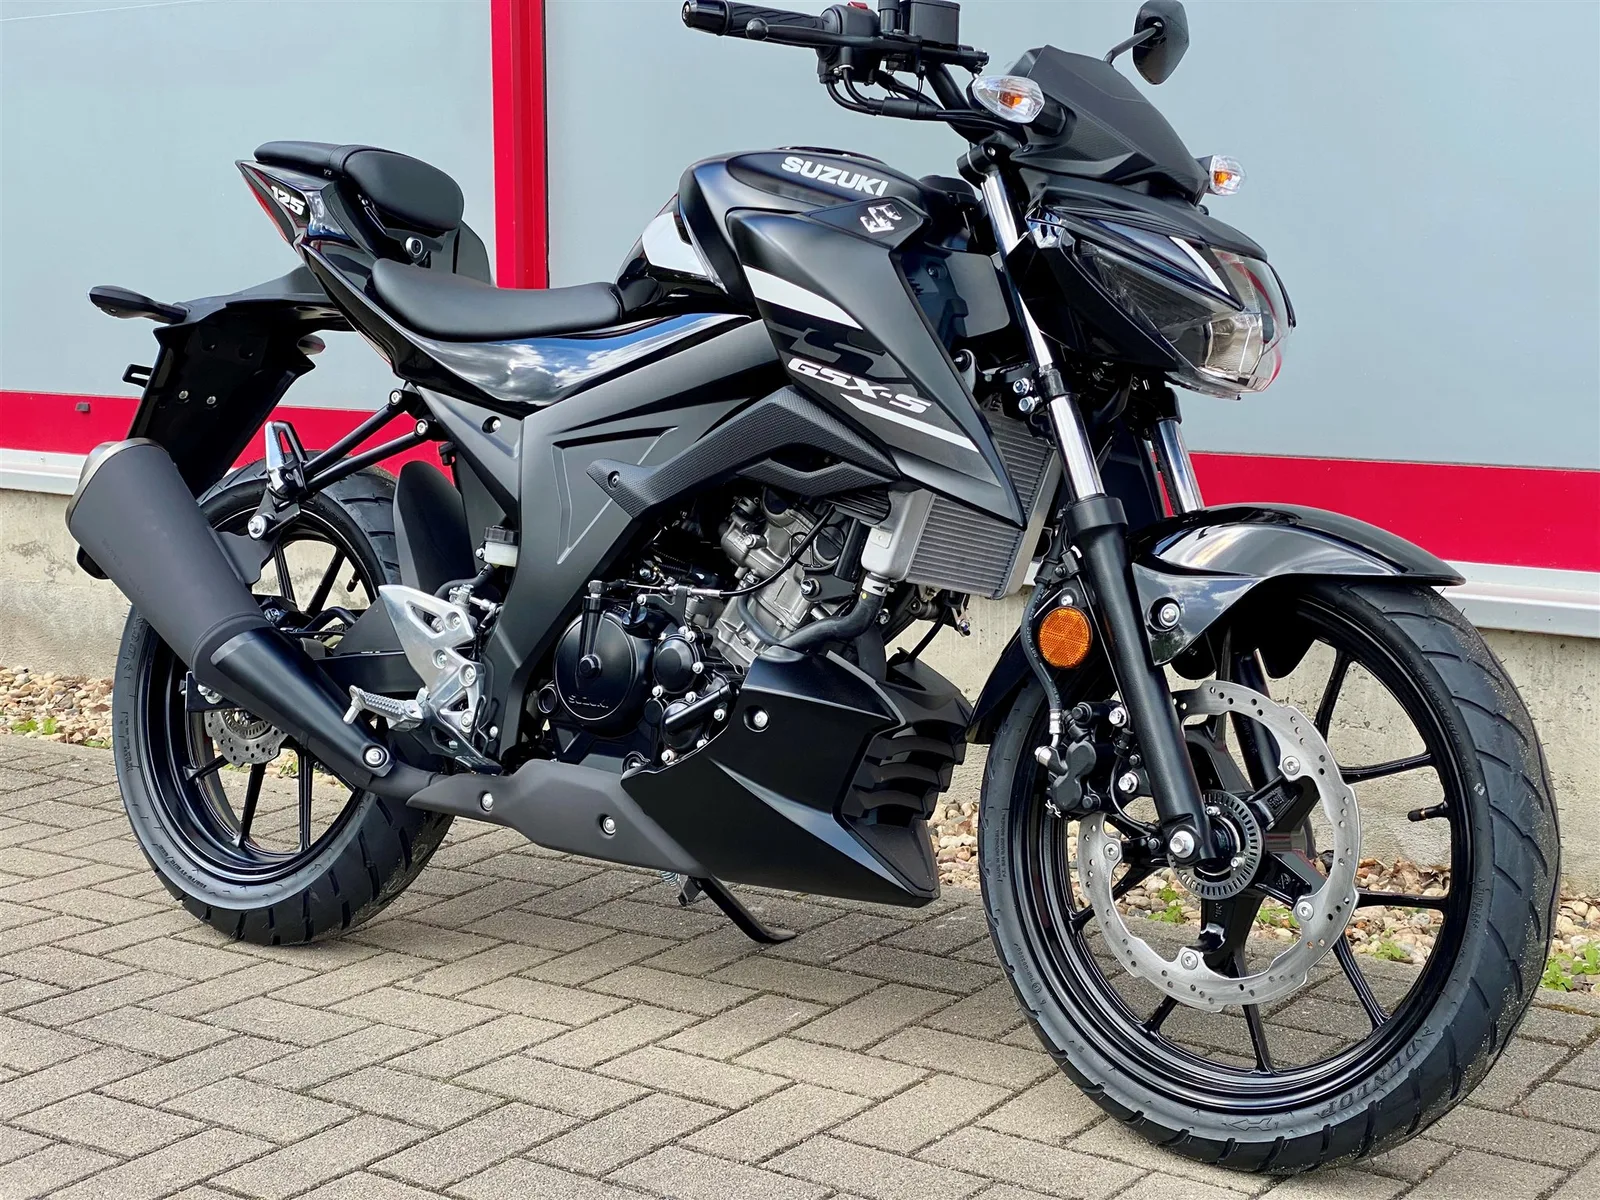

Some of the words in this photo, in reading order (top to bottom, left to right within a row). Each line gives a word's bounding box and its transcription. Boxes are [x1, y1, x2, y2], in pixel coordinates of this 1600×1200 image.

[781, 156, 889, 197] SUZUKI
[271, 185, 306, 216] 125
[787, 357, 932, 414] GSX-S
